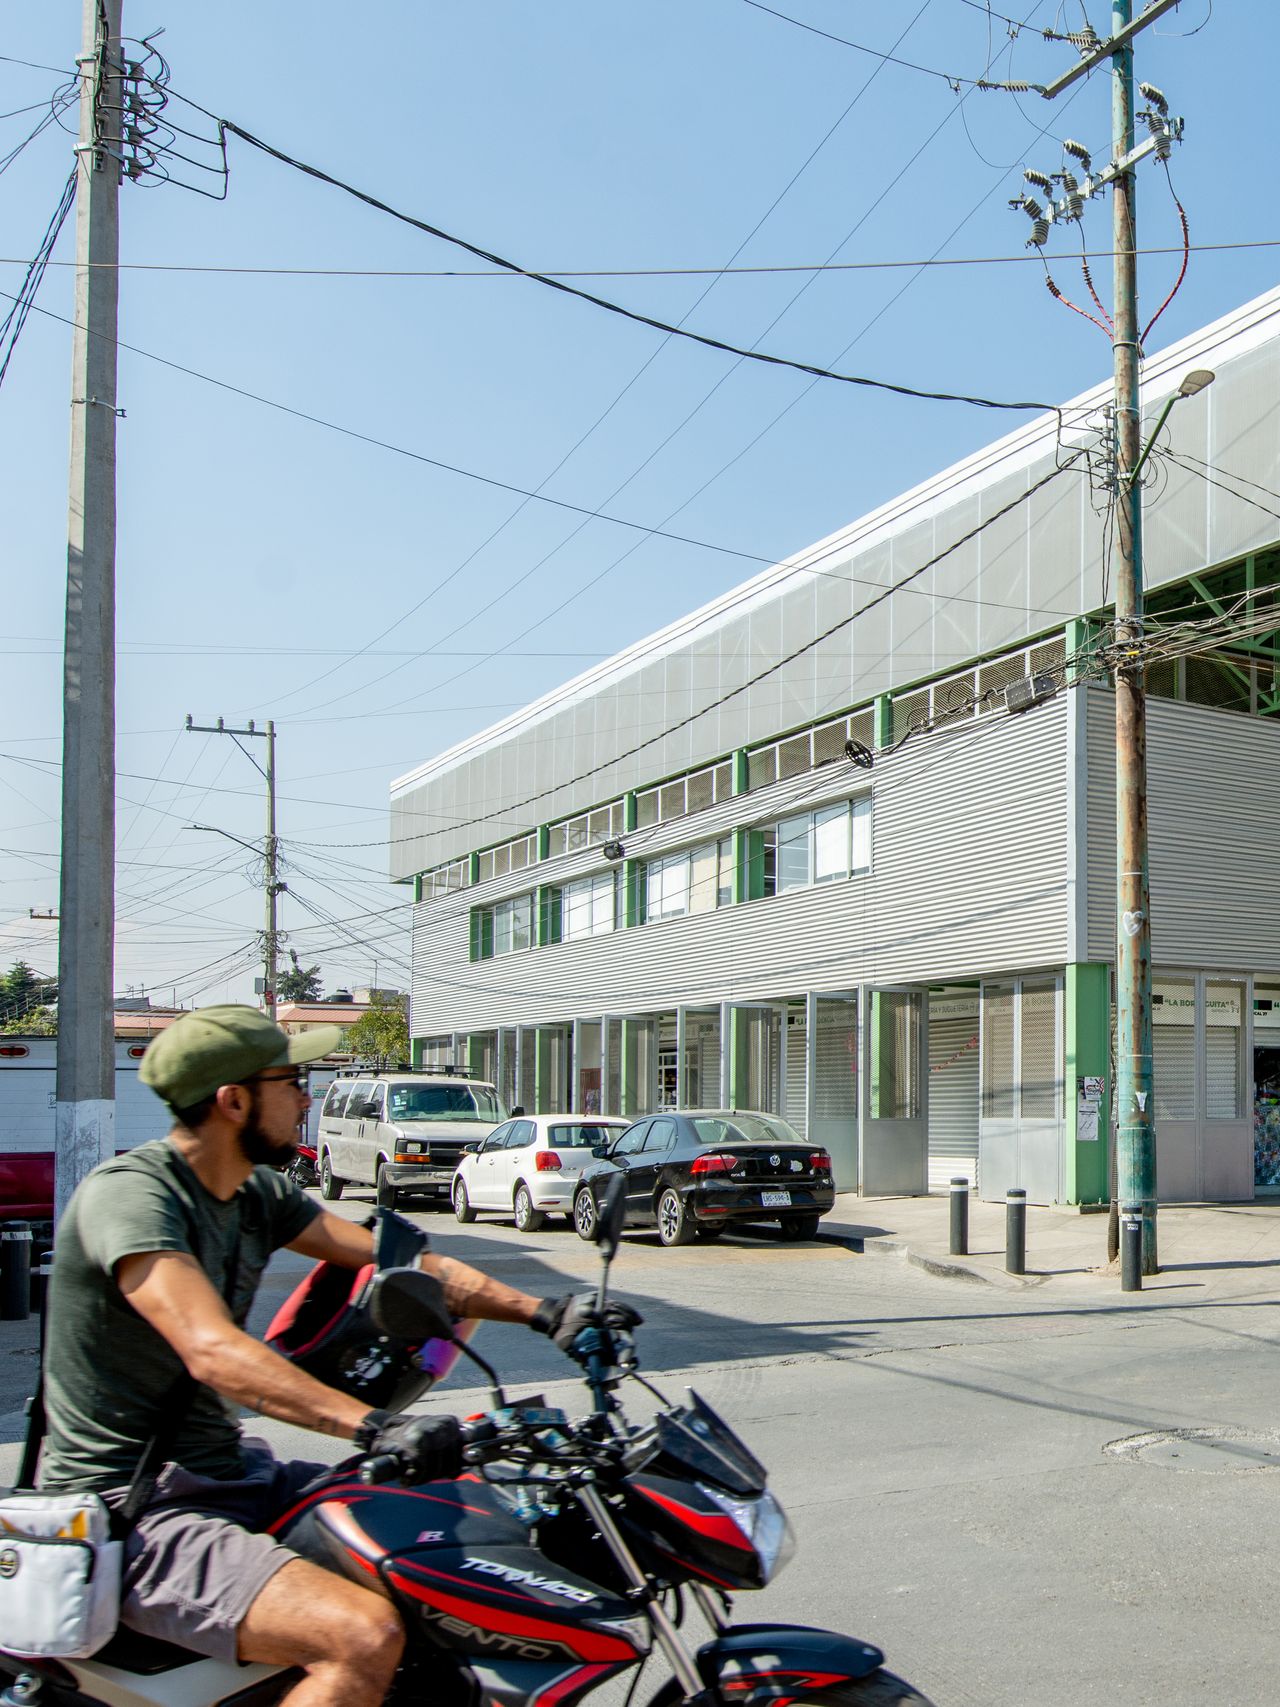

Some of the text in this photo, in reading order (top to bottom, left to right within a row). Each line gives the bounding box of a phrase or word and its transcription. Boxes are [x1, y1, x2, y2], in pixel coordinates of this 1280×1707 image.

[1180, 999, 1230, 1008] BORGUITA”
[459, 1557, 599, 1602] TORNADO
[421, 1603, 553, 1660] VENTO
